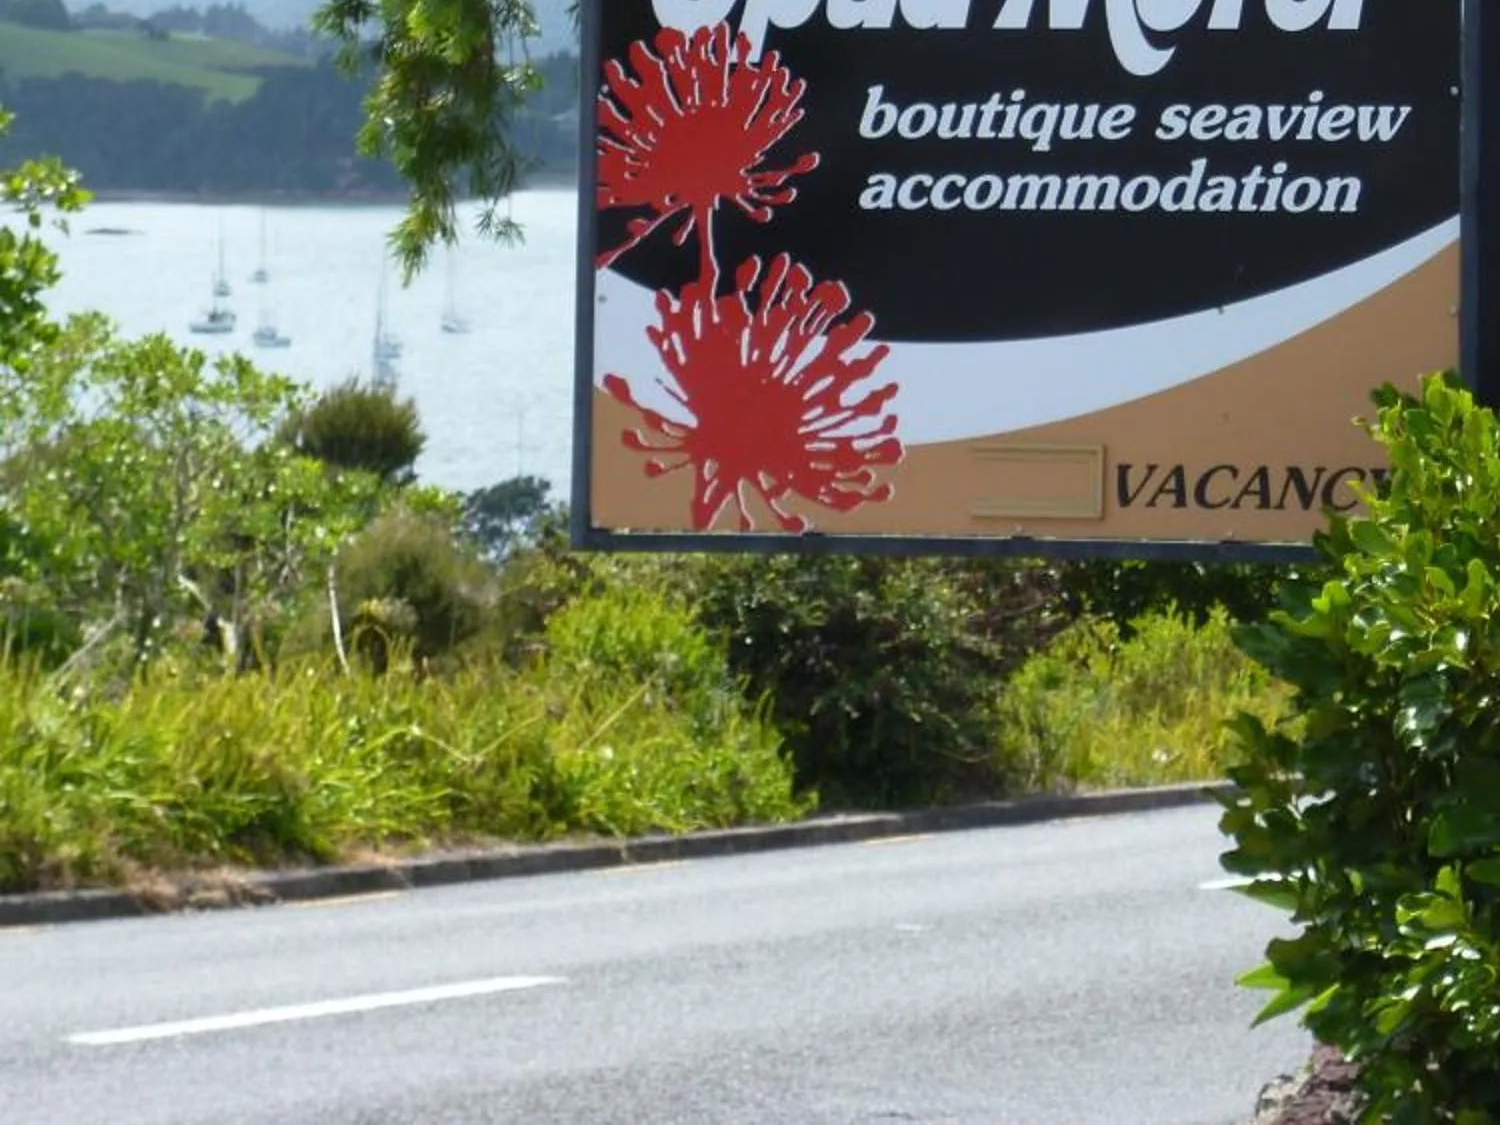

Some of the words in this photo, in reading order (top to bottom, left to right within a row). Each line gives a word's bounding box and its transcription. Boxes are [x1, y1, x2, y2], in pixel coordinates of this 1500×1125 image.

[858, 84, 1135, 152] boutique
[1154, 90, 1412, 143] seaview
[858, 157, 1362, 213] accommodation
